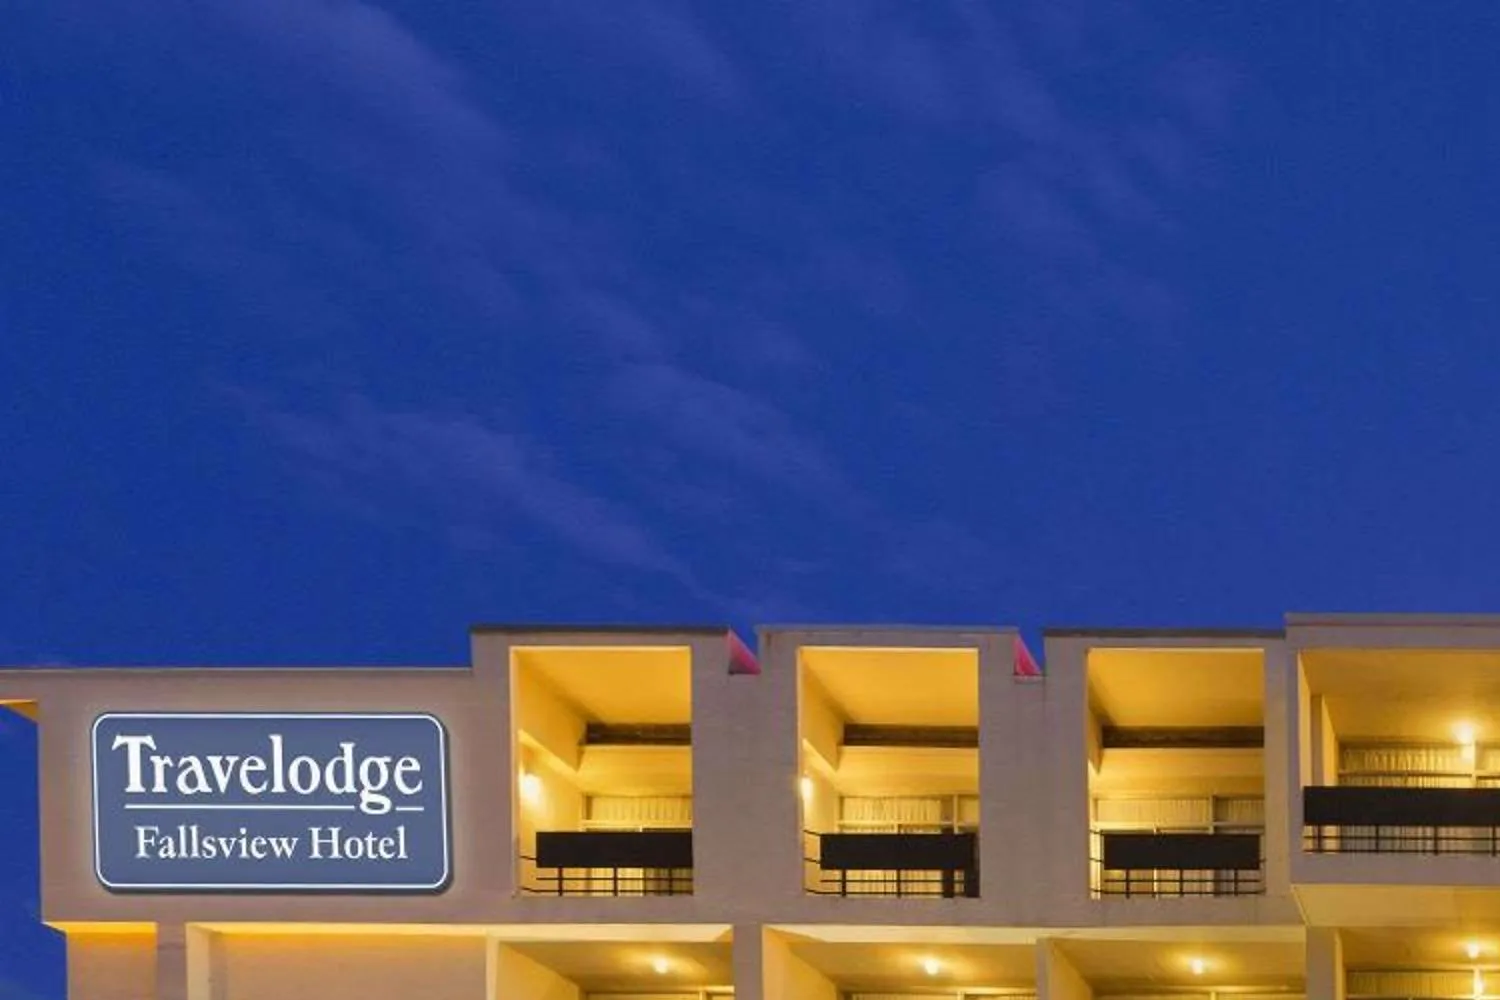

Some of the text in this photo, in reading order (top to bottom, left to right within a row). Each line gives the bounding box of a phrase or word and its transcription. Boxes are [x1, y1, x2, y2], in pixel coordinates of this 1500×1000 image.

[112, 734, 424, 815] Travelodge
[135, 825, 409, 860] Fallsview Hotel
